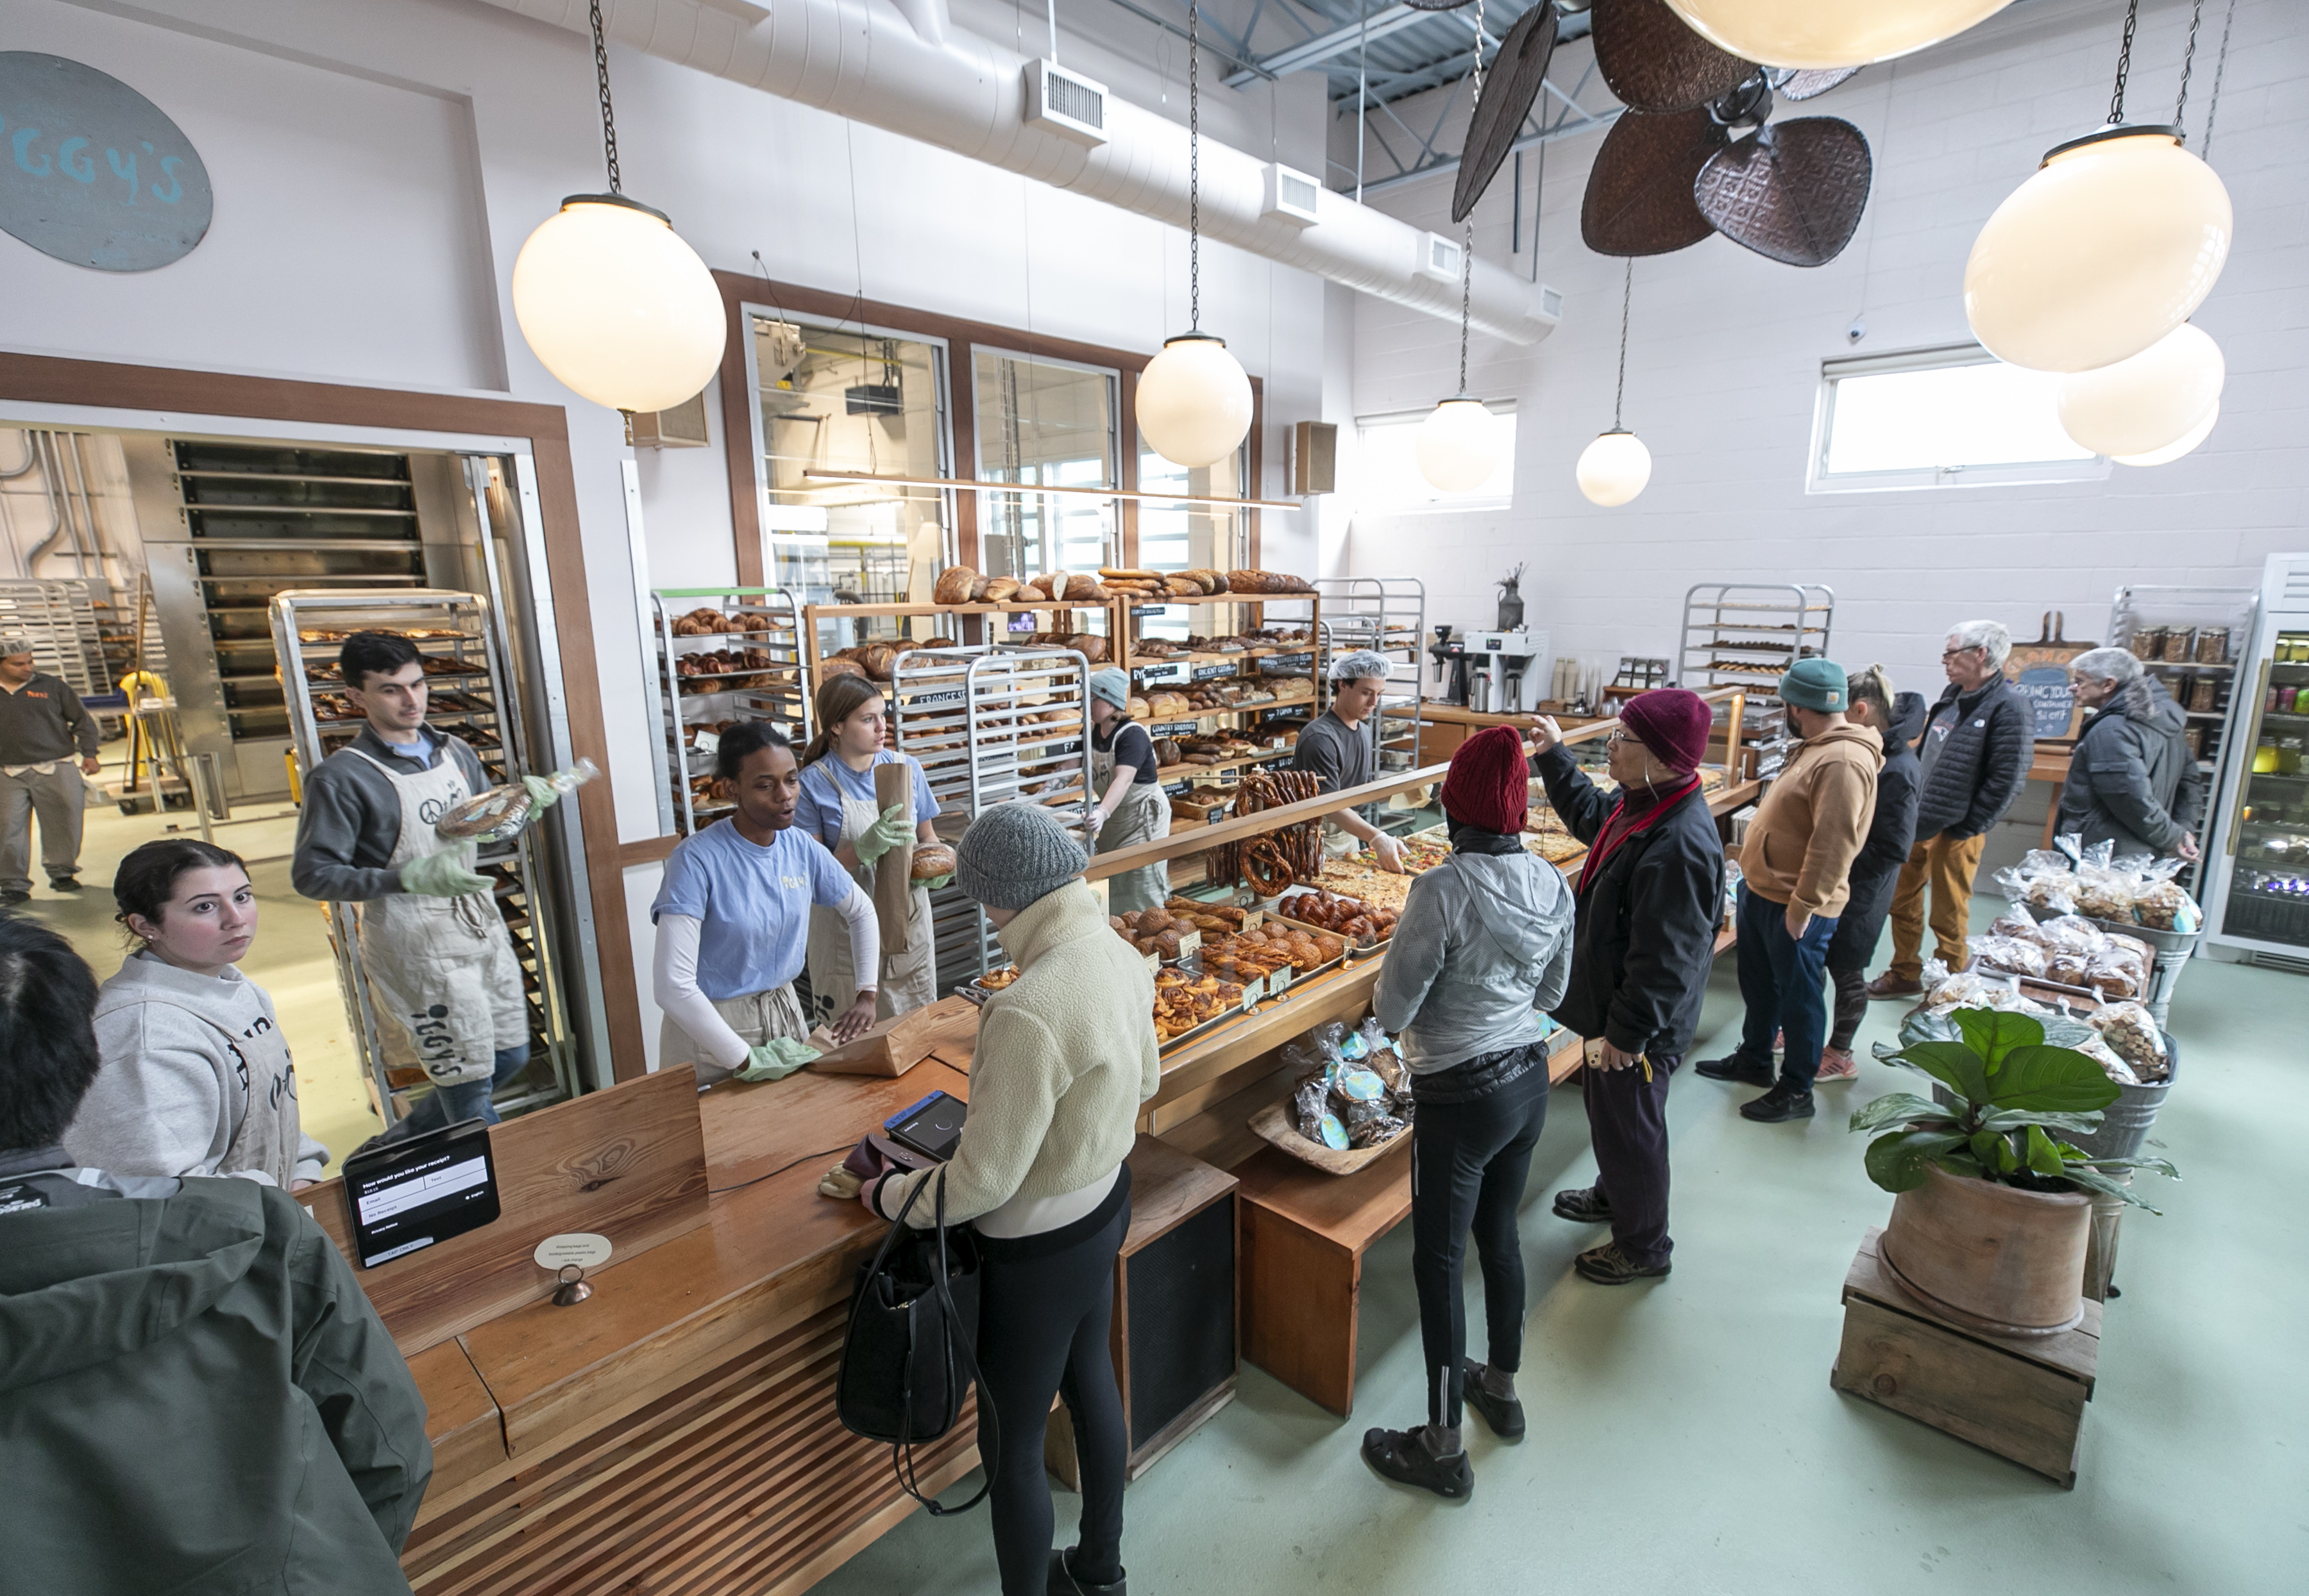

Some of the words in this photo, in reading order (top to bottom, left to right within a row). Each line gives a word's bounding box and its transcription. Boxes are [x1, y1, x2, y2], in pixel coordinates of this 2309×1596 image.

[1133, 669, 1147, 680] RYE
[1152, 724, 1173, 733] COUNTRY
[1174, 723, 1196, 731] SOURDOUGH
[894, 1111, 907, 1121] TAP
[908, 1102, 924, 1114] ONLY
[376, 1175, 393, 1186] would
[394, 1171, 405, 1180] you
[405, 1167, 415, 1175] like
[415, 1163, 428, 1172] your
[428, 1155, 450, 1167] receipt?
[366, 1197, 381, 1205] Email
[377, 1205, 398, 1216] Receipt
[371, 1225, 385, 1234] Privacy
[385, 1222, 398, 1230] Notice
[387, 1248, 398, 1257] TAP
[399, 1243, 414, 1253] ONLY
